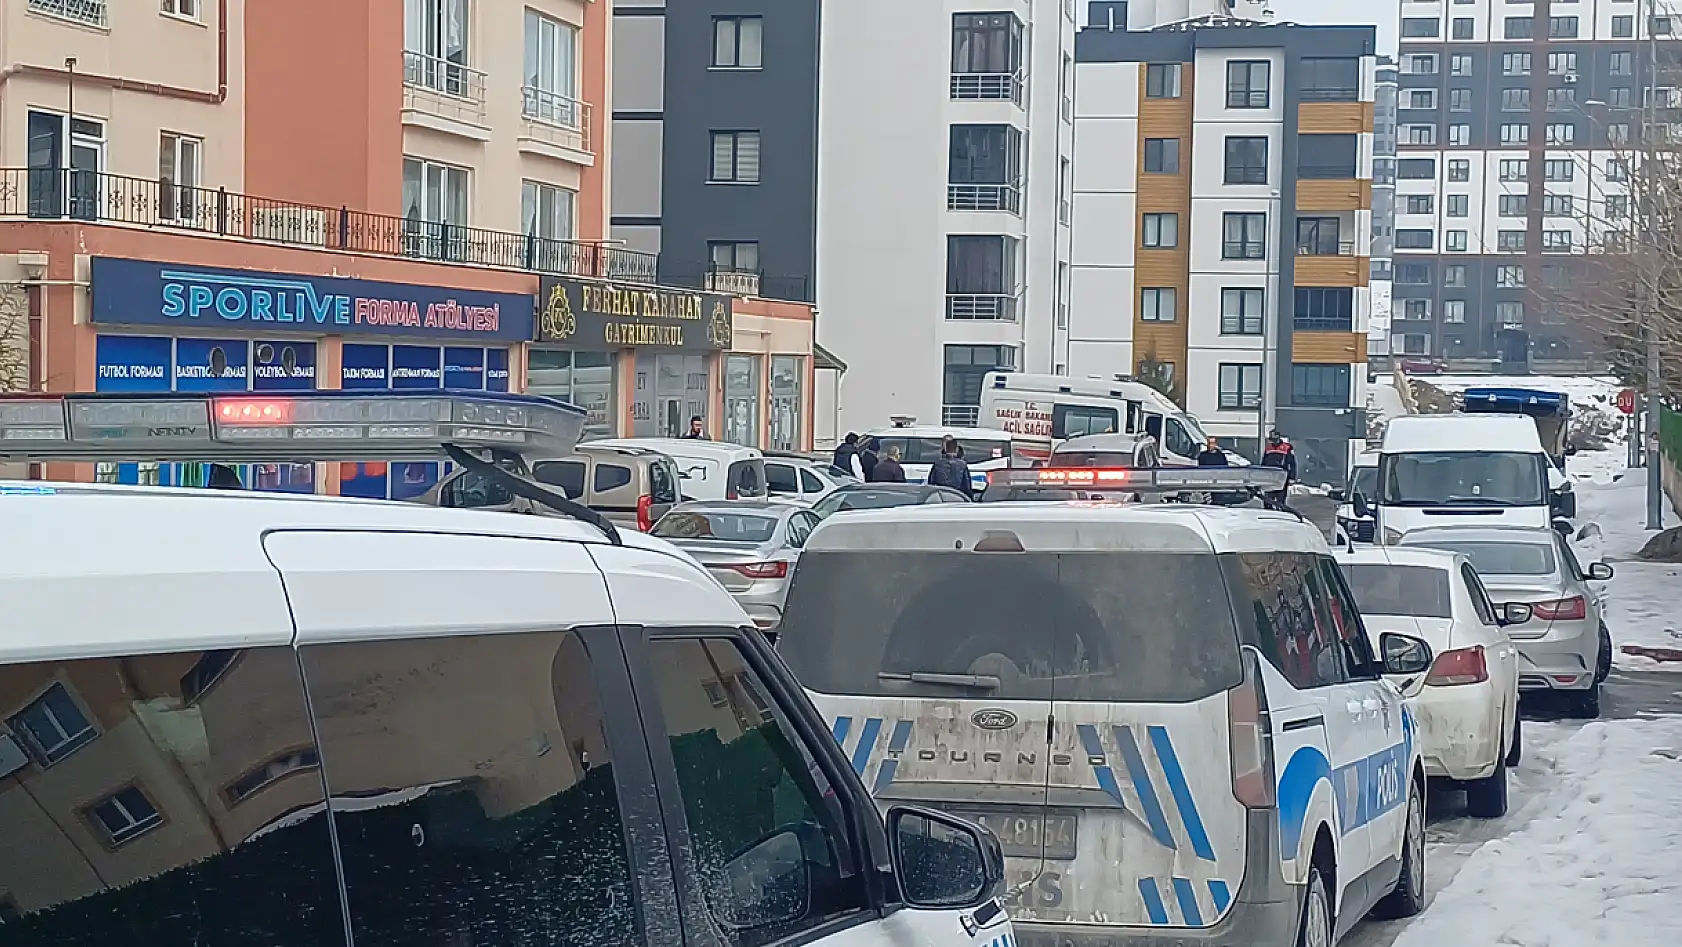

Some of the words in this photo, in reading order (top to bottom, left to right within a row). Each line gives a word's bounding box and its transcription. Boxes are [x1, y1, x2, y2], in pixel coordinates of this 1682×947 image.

[582, 285, 638, 316] FERHAT
[642, 291, 703, 321] KARAHAN
[355, 297, 420, 327] FORMA
[424, 299, 500, 332] ATÖLYESİ
[604, 318, 684, 346] GAYRİMENKUL
[99, 365, 130, 378] FUTBOL
[130, 365, 164, 378] FORMASI
[1617, 396, 1633, 407] DU
[887, 749, 1106, 766] TOURNEO
